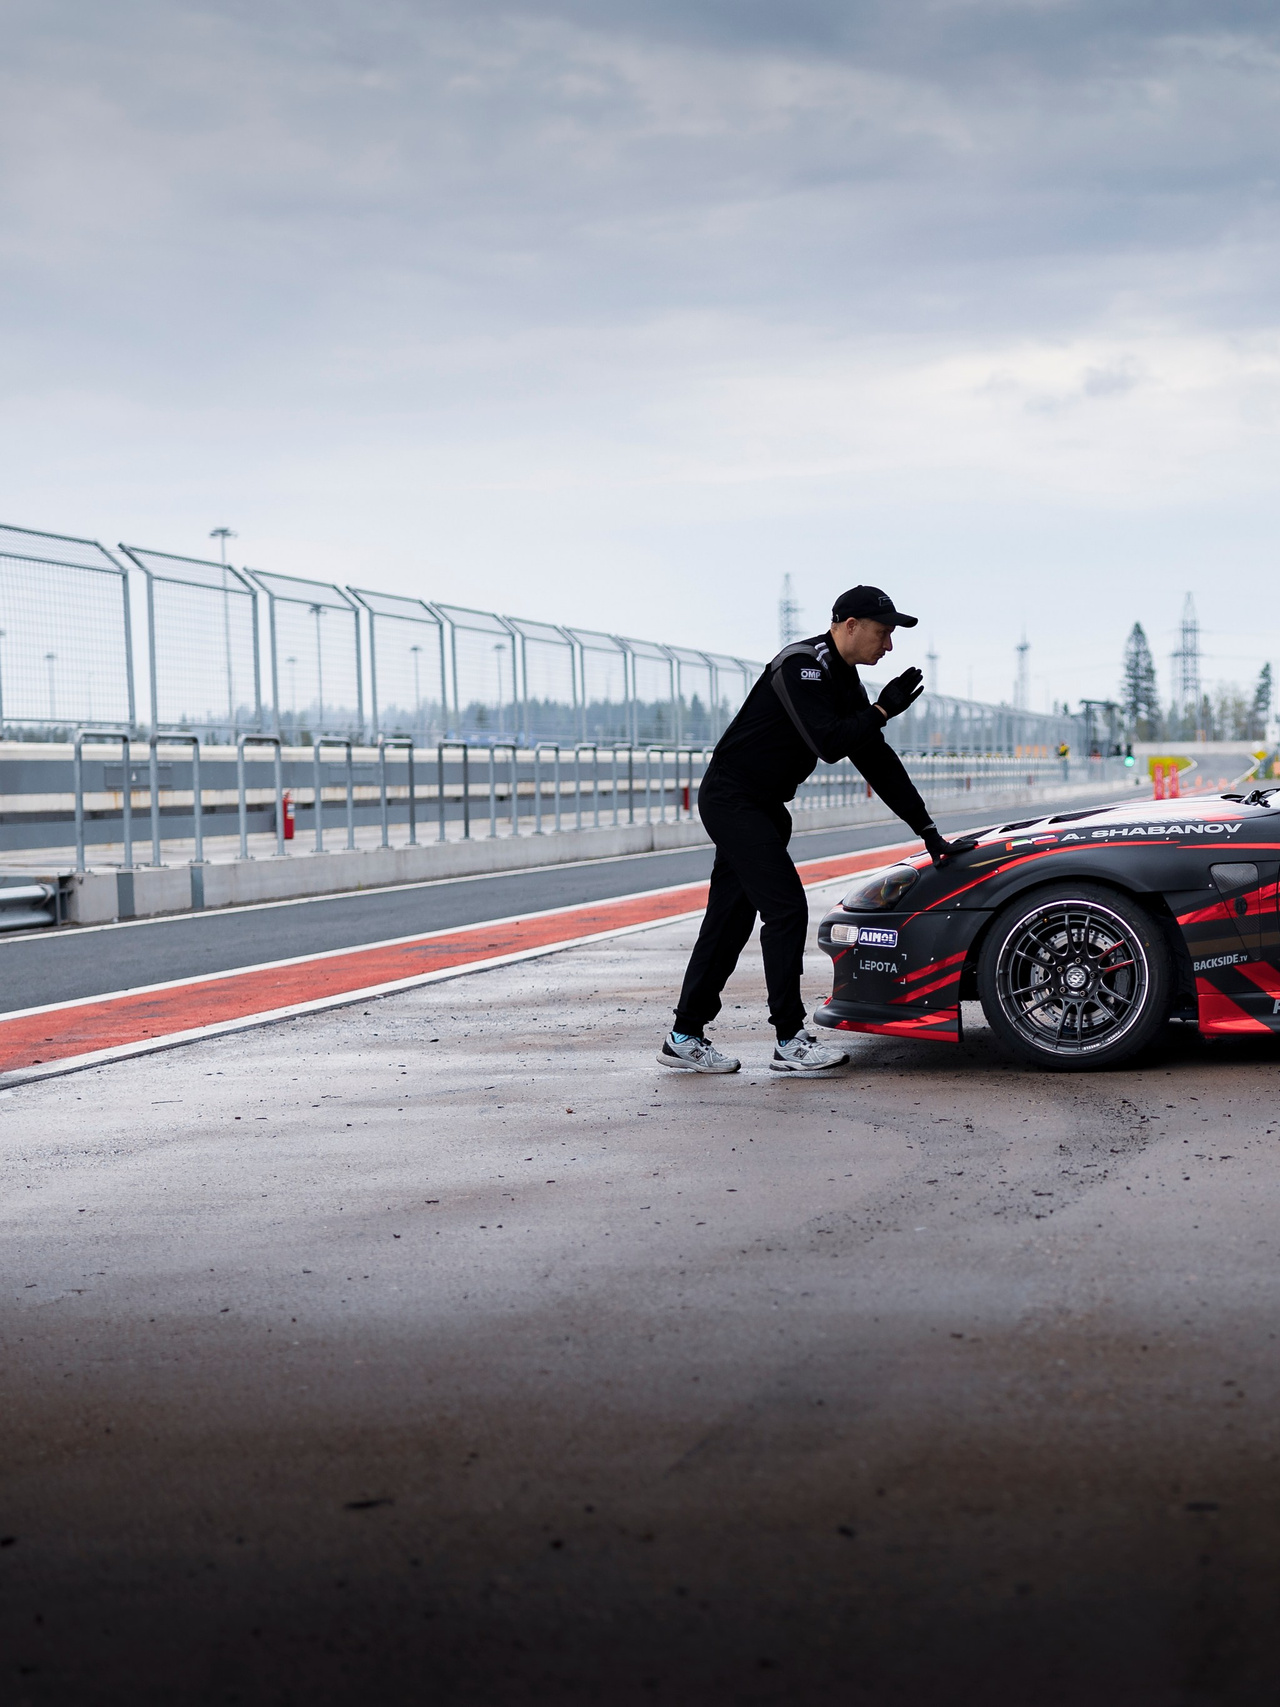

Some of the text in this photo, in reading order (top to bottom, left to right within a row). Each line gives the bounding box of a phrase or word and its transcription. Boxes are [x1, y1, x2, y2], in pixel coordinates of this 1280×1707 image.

[801, 670, 820, 679] OMP
[1061, 824, 1242, 841] A. SHABANOV
[860, 931, 895, 944] AIMOL
[860, 960, 898, 973] LEPOTA
